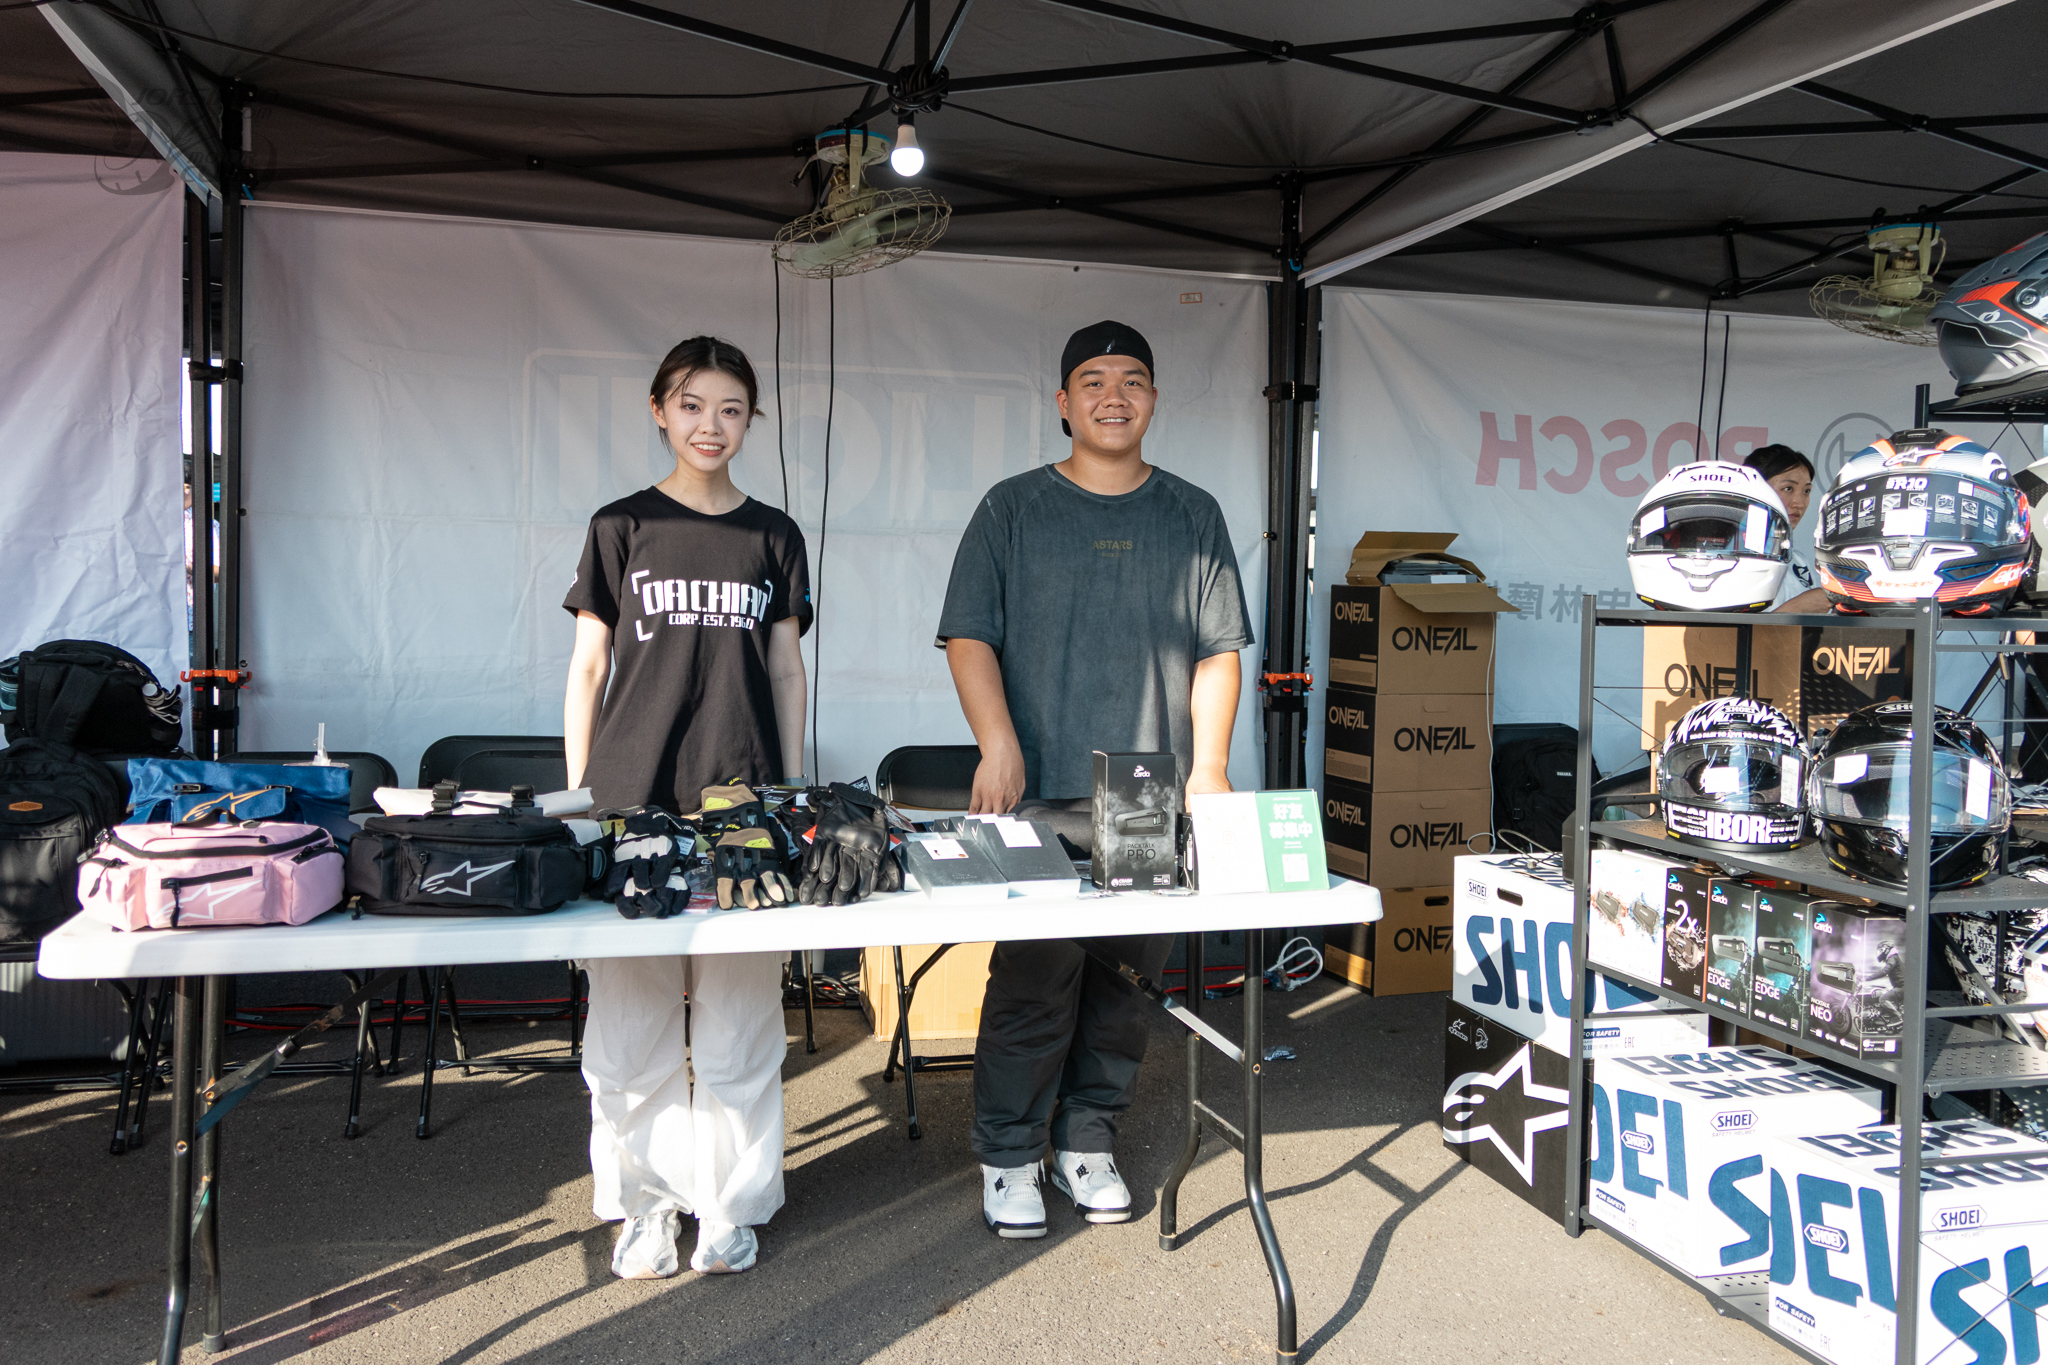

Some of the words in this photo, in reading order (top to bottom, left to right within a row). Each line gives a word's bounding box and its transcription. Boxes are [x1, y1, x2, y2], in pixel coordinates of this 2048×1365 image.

[1690, 474, 1732, 484] SHOEI
[1093, 540, 1133, 550] ASTARS
[668, 613, 701, 625] CORP.
[703, 614, 728, 627] EST.
[1664, 663, 1773, 700] O'NEL
[1133, 770, 1151, 778] cardo
[1273, 802, 1304, 820] 好友
[1127, 849, 1156, 860] PRO
[1468, 881, 1488, 898] SHOEI
[1667, 882, 1684, 893] cardo
[1711, 894, 1728, 905] cardo
[1759, 902, 1773, 913] cardo
[1813, 921, 1833, 934] cardo
[1394, 925, 1453, 956] O'NE
[1707, 972, 1731, 990] EDGE
[1755, 981, 1780, 1000] EDGE
[1810, 1004, 1832, 1023] NEO
[1669, 1069, 1866, 1100] SHOEI
[1717, 1113, 1752, 1129] SHOEI
[1624, 1132, 1650, 1151] SHOEI
[1711, 1130, 1733, 1138] SAFETY
[1734, 1129, 1756, 1137] HELMET
[1607, 1194, 1626, 1212] SAFETY
[1940, 1209, 1981, 1228] SHOEI
[1810, 1228, 1841, 1248] SHOEI
[1933, 1233, 1958, 1242] SAFETY
[1960, 1231, 1985, 1240] HELMET
[1790, 1304, 1815, 1327] SAFETY
